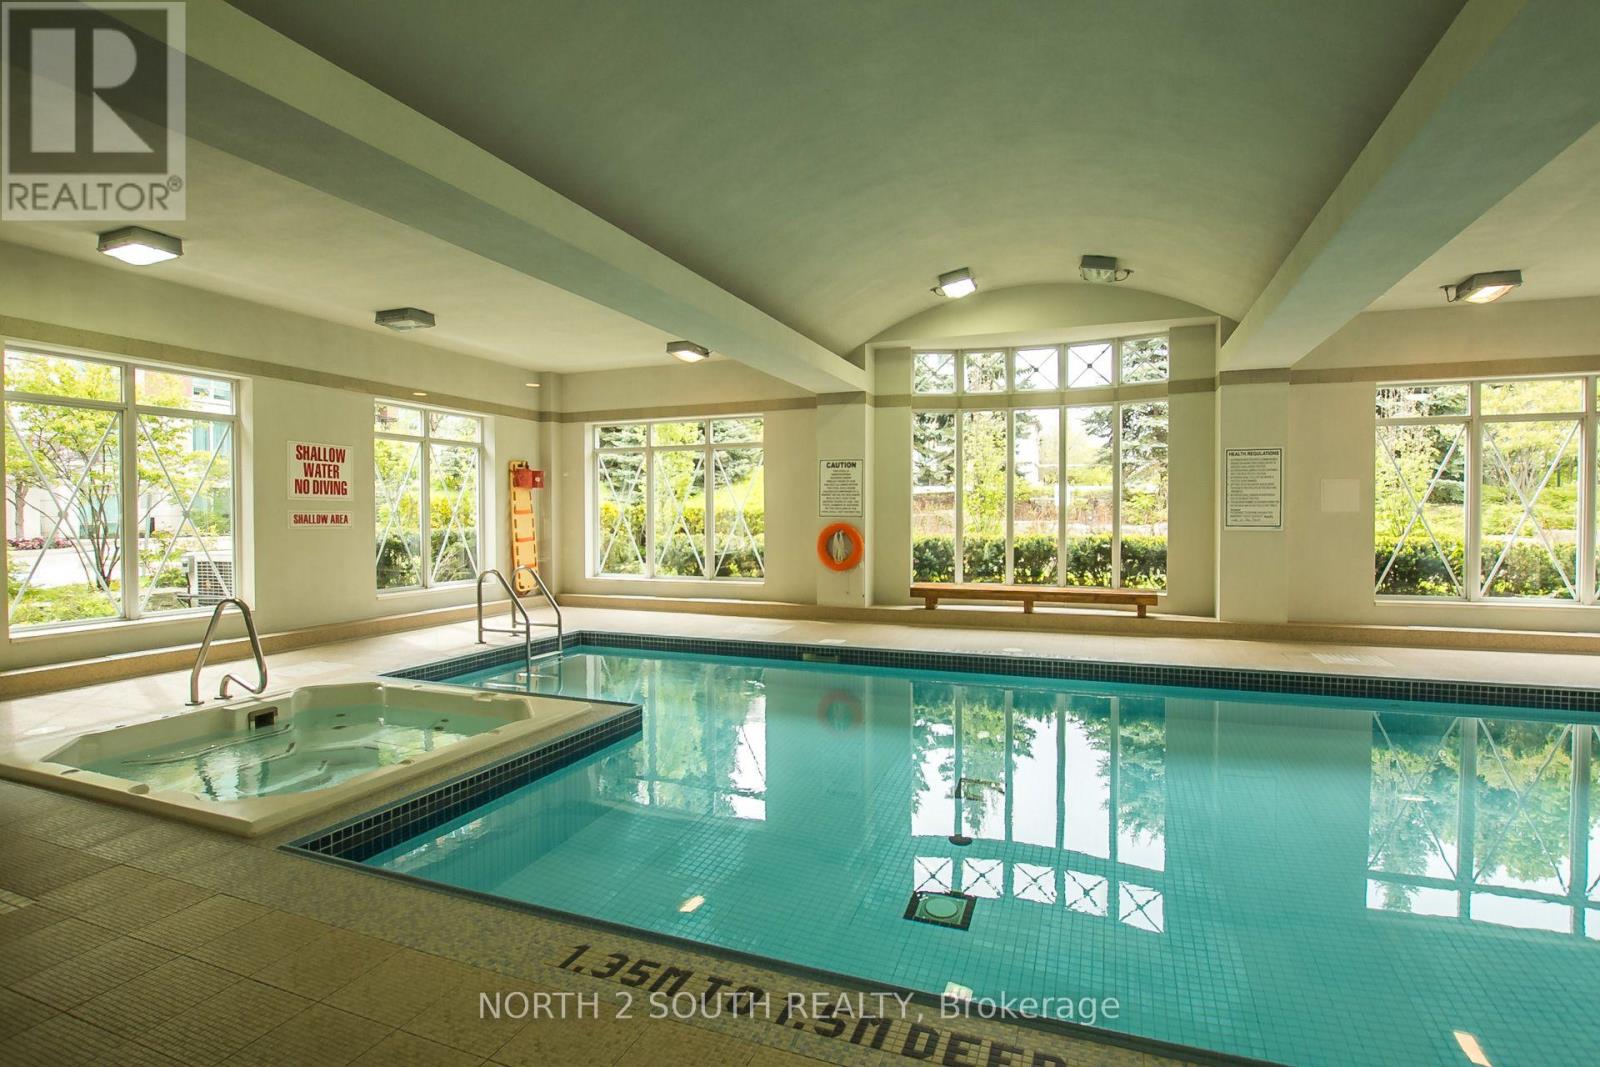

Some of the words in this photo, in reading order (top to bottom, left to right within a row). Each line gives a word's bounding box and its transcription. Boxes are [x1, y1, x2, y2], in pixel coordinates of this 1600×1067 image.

[295, 444, 346, 463] SHALLOW
[303, 462, 340, 479] WATER
[294, 479, 310, 494] NO
[312, 480, 348, 496] DIVING
[293, 514, 329, 524] SHALLOW
[330, 514, 349, 524] AREA
[558, 943, 696, 997] 1.35M
[699, 975, 765, 1016] TO
